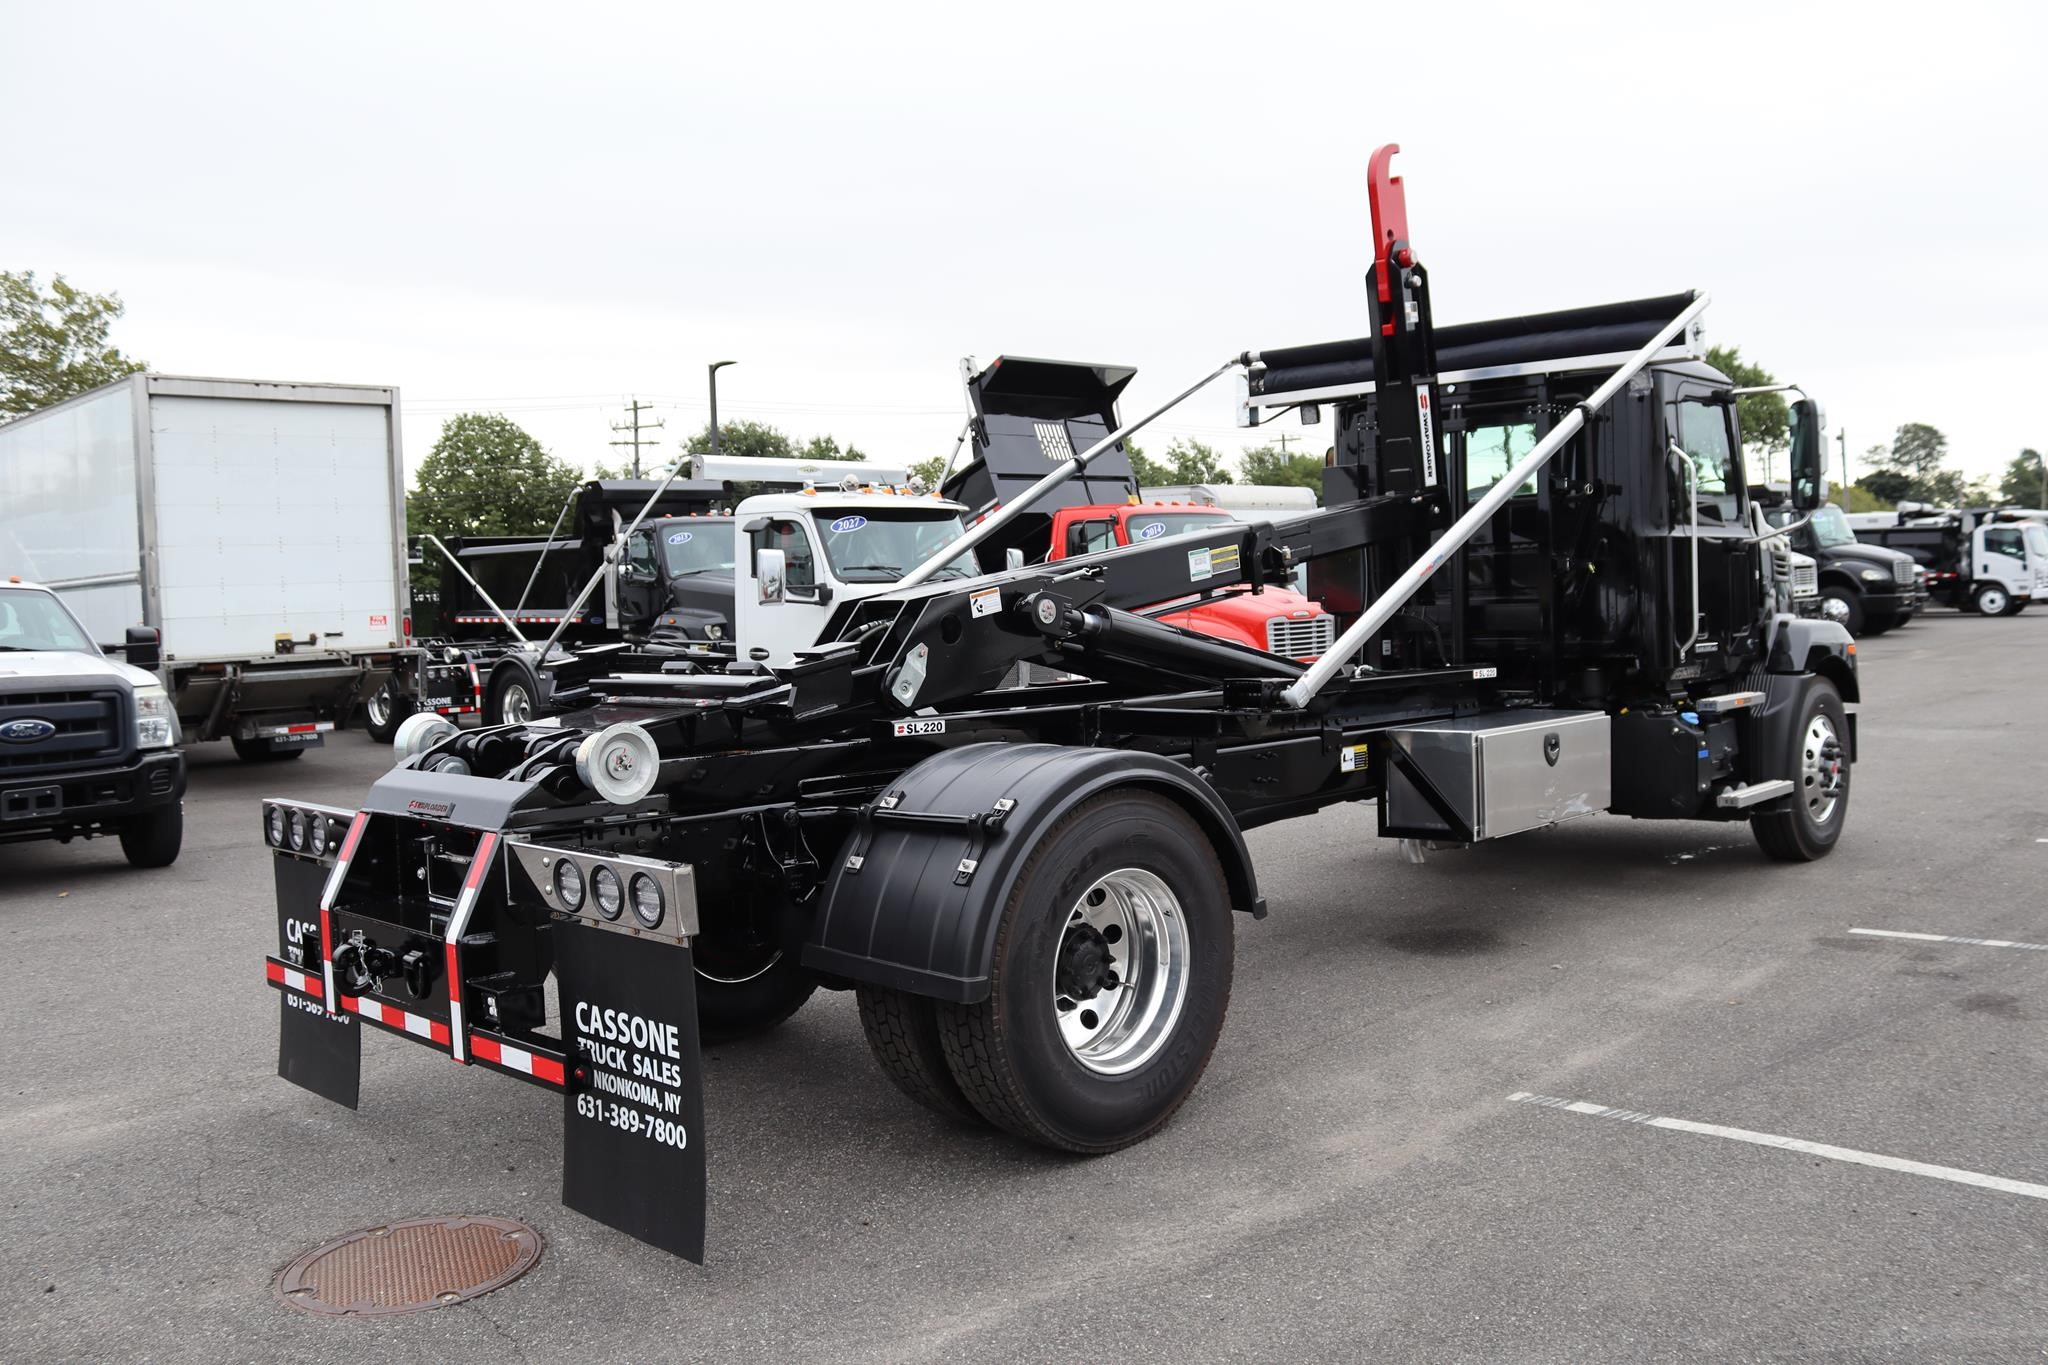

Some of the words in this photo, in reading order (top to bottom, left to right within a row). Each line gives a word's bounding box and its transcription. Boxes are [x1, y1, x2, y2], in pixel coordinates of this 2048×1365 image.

[1422, 412, 1433, 478] SWAPLOADER
[10, 723, 42, 737] Ford
[575, 1001, 680, 1060] CASSONE
[593, 1069, 663, 1112] NKONKOMA,
[664, 1091, 682, 1115] NY
[632, 1053, 682, 1088] SALES
[577, 1093, 687, 1150] 631-389-7800
